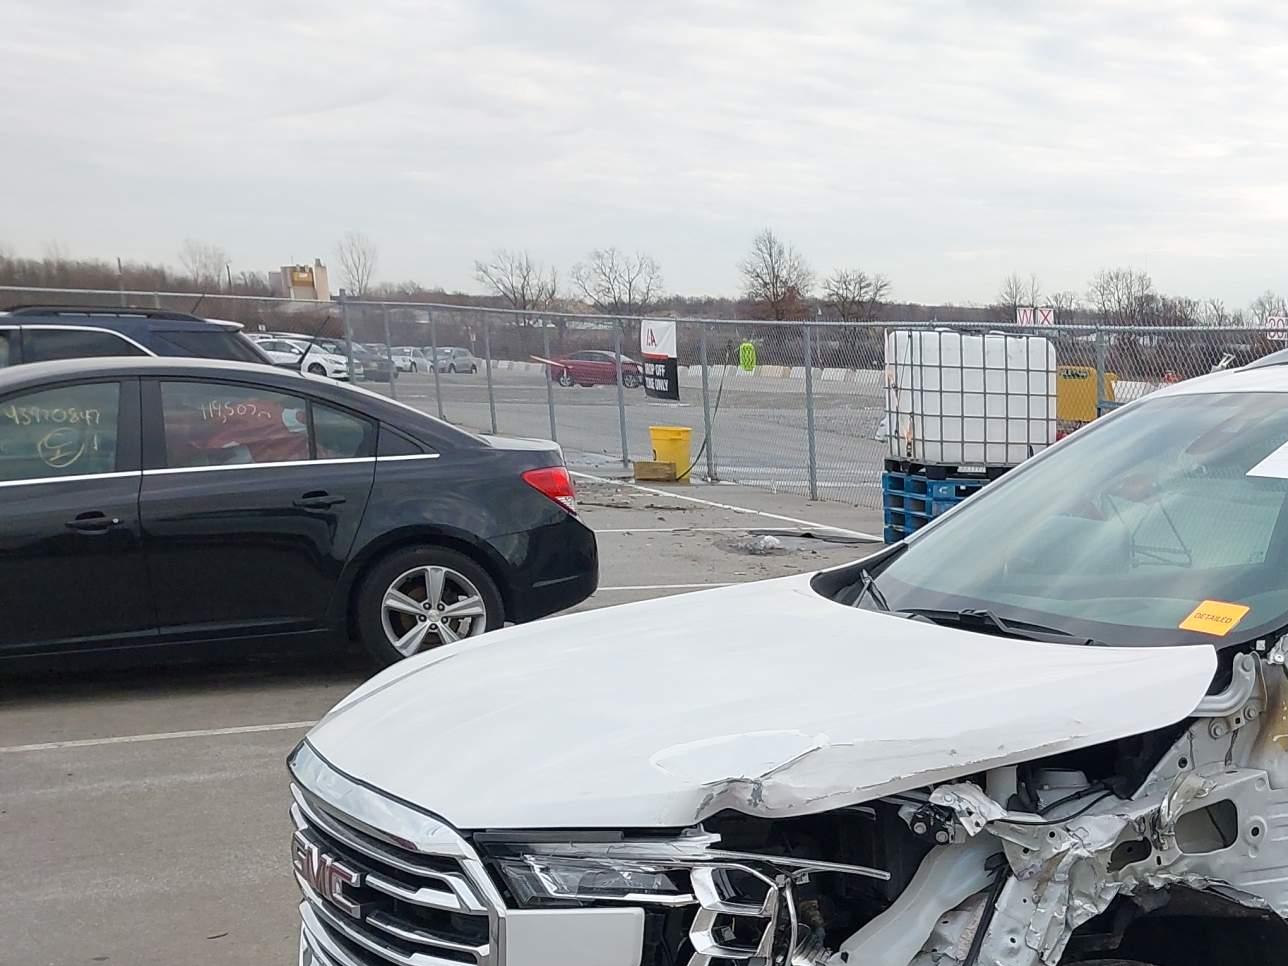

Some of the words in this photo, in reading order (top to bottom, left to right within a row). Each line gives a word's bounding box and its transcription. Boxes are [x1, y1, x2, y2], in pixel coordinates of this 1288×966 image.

[1040, 309, 1054, 326] X
[655, 364, 666, 377] OFF
[1194, 612, 1233, 624] DETAILED
[291, 830, 361, 920] GMC
